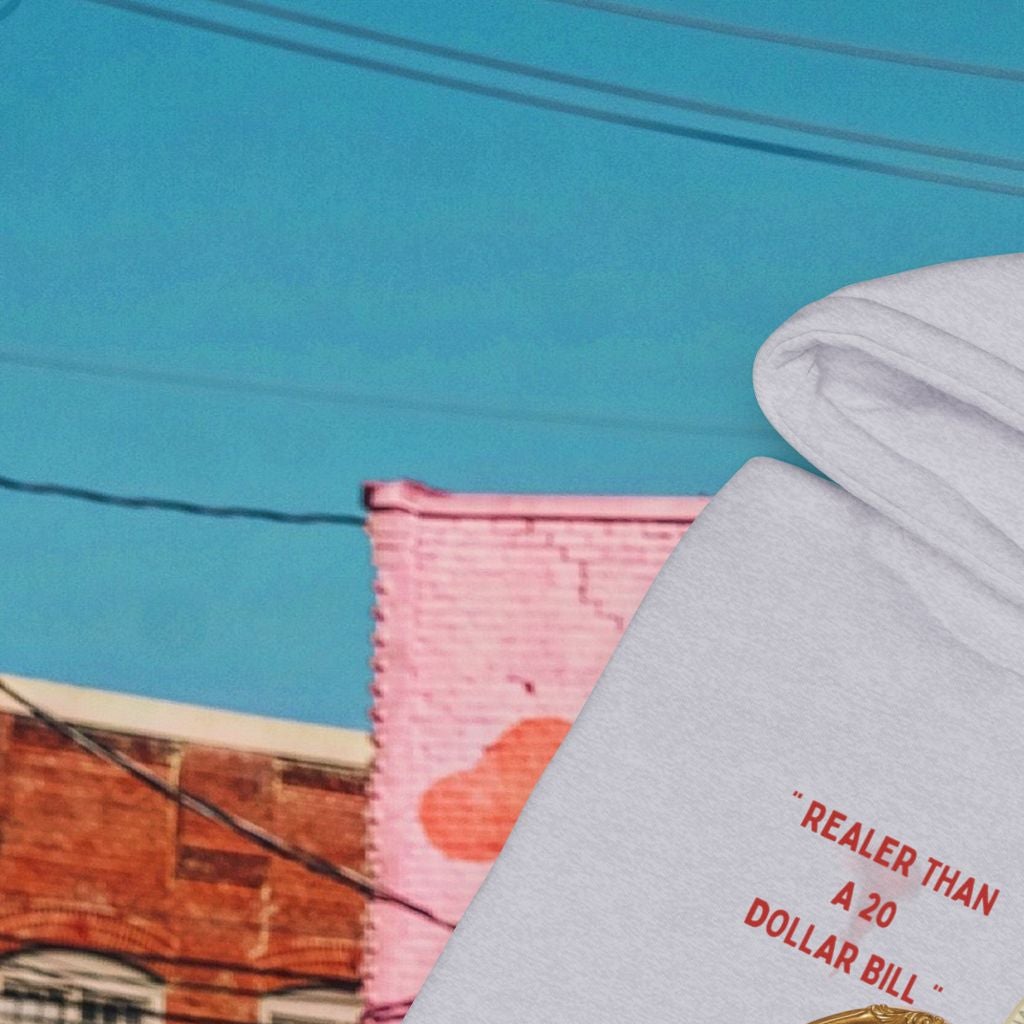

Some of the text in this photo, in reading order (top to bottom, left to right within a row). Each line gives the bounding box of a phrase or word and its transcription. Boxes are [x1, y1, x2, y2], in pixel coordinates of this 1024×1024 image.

[830, 880, 898, 928] A 20
[921, 856, 1001, 917] THAN
[743, 896, 859, 975] DOLLAR
